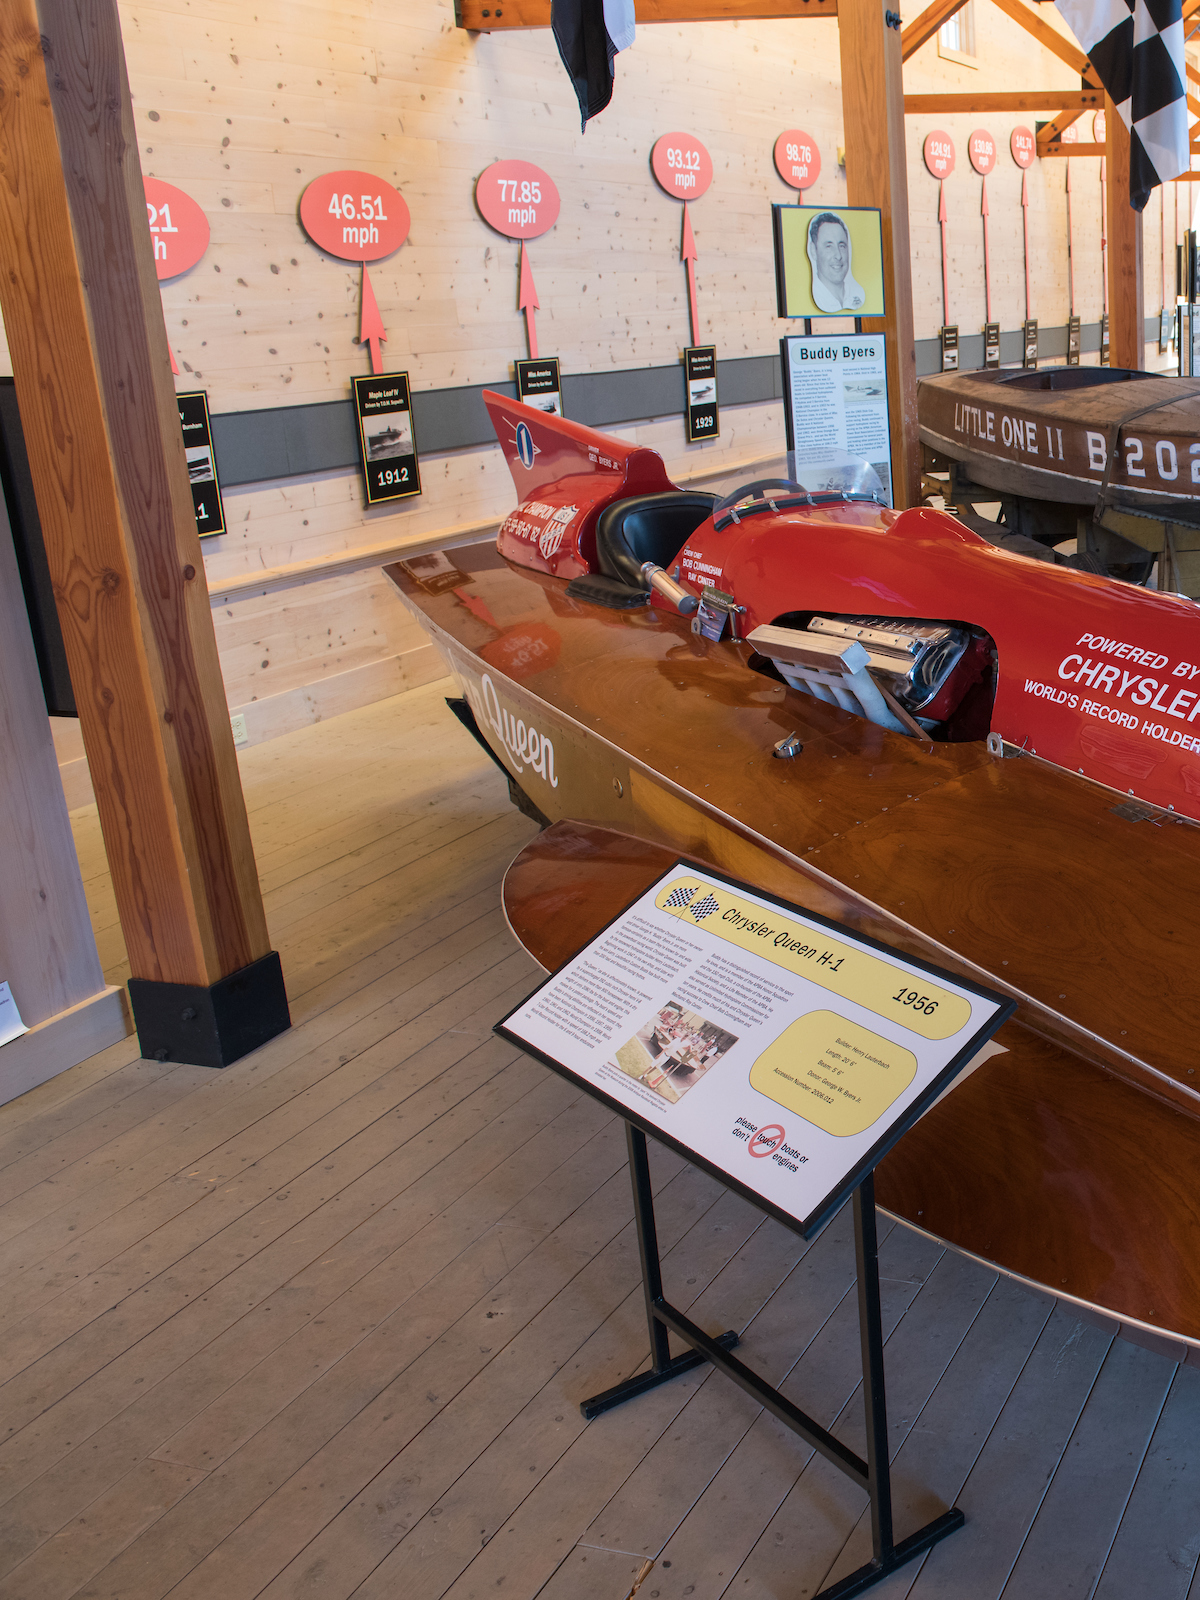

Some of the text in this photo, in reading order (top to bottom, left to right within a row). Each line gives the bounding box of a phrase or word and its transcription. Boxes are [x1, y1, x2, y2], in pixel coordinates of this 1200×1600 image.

[666, 148, 700, 170] 93.12
[786, 143, 812, 164] 98.76
[930, 141, 951, 158] 124.91
[1019, 150, 1029, 161] mph
[935, 158, 946, 171] mph
[979, 155, 989, 168] mph
[675, 171, 696, 190] mph
[792, 164, 808, 180] mph
[497, 179, 542, 204] 77.85
[328, 193, 388, 220] 46.51
[146, 203, 178, 232] 21
[508, 206, 536, 227] mph
[342, 223, 379, 248] mph
[800, 346, 876, 361] Buddy Byers
[368, 391, 383, 399] Maple
[383, 389, 393, 397] Leaf
[695, 416, 714, 429] 1929
[954, 403, 1064, 460] LITTLE ONE II
[1086, 431, 1108, 472] B
[599, 456, 612, 468] BYERS
[378, 467, 409, 486] 1912
[684, 549, 694, 557] CREW
[683, 558, 723, 577] BOB CUNNINGHAM
[688, 572, 715, 588] RAY CANTER
[1076, 633, 1169, 670] POWERED
[1024, 679, 1080, 708] WORLD'S
[1080, 698, 1139, 730] RECORD
[482, 673, 558, 788] Queen
[722, 908, 845, 972] Chrysler Queen H-1
[892, 988, 938, 1015] 1956
[826, 1048, 842, 1060] Length:
[835, 1038, 890, 1069] Builder: Henry Lauterbach
[817, 1059, 832, 1070] Beam:
[773, 1067, 834, 1104] Accession Number: 2006.012
[807, 1070, 822, 1081] Donor:
[821, 1078, 838, 1090] George
[843, 1090, 856, 1100] Byers
[734, 1117, 758, 1132] please
[732, 1128, 750, 1142] don't
[756, 1134, 777, 1147] touch
[780, 1143, 800, 1159] boats
[772, 1154, 799, 1172] engines
